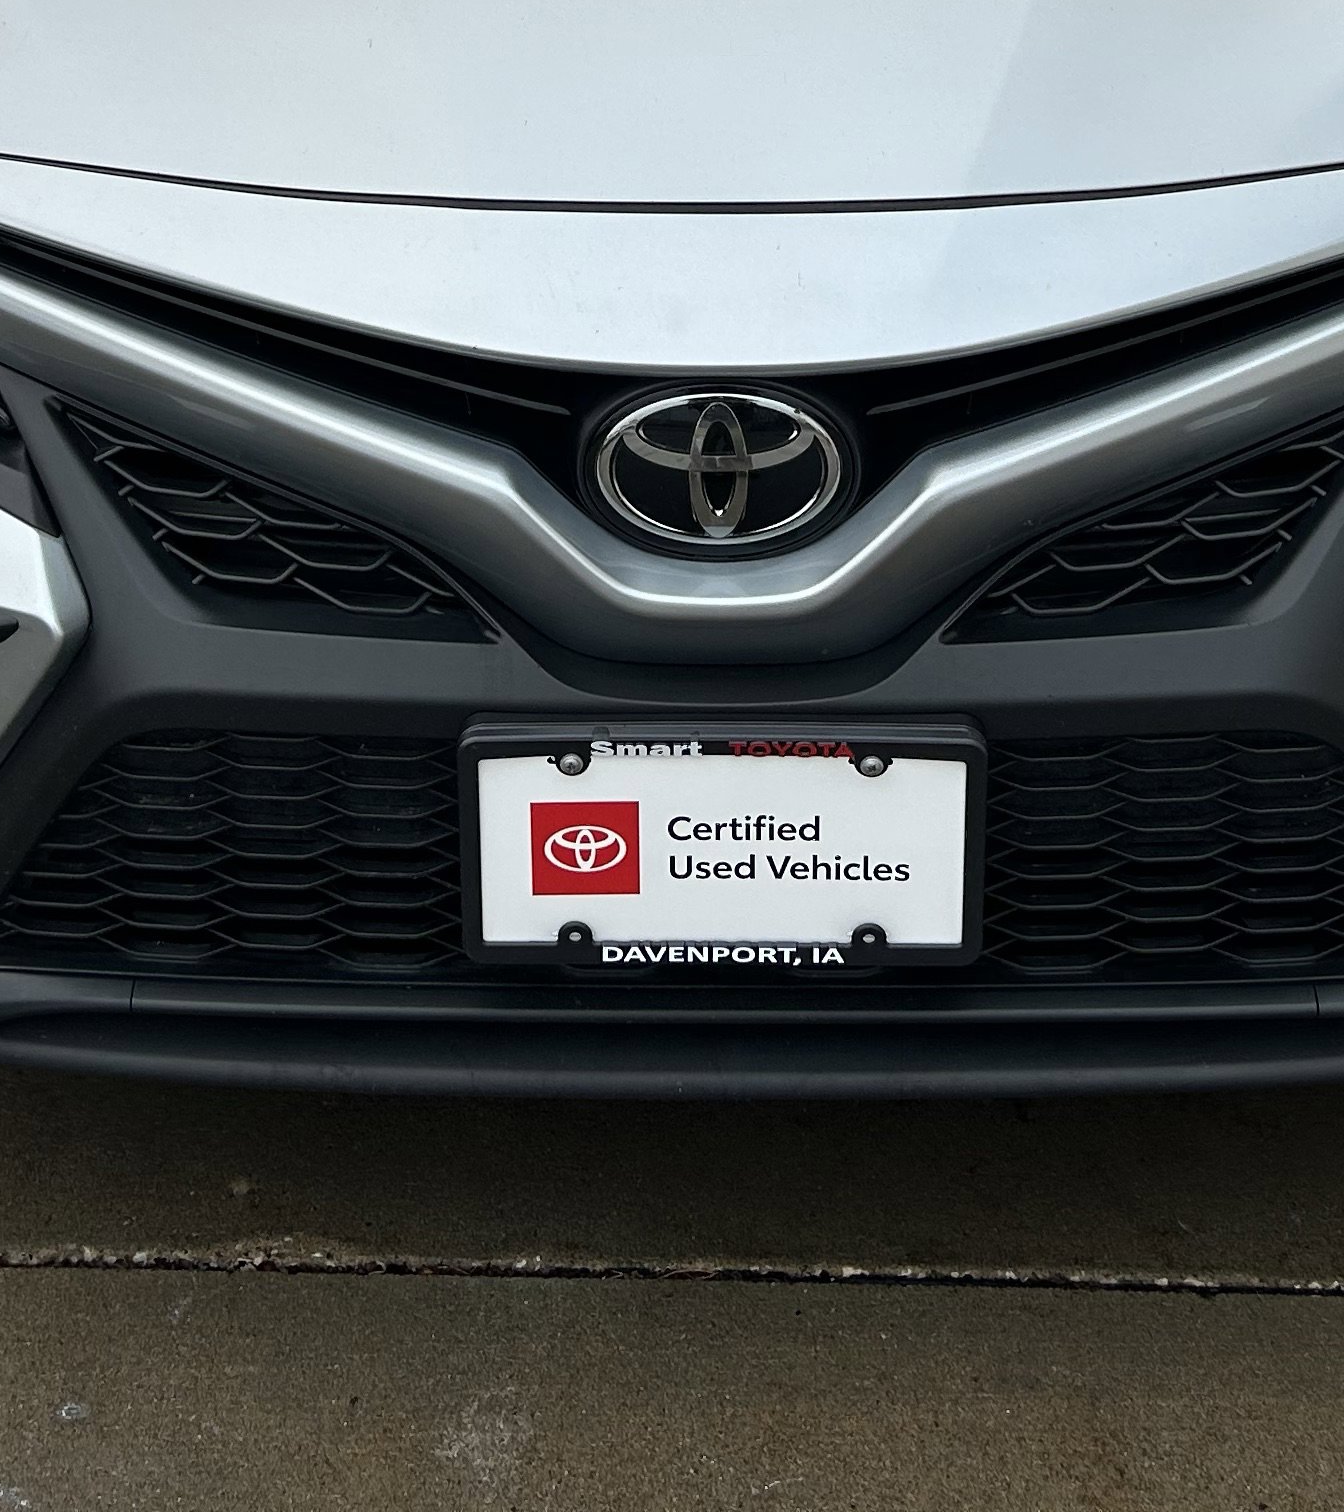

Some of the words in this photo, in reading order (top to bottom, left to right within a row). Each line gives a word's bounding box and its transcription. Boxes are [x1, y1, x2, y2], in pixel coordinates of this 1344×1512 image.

[589, 740, 703, 758] Smart
[728, 741, 855, 758] TOYOTA
[667, 815, 821, 842] Certified
[668, 854, 757, 880] Used
[766, 854, 911, 882] Vehicles
[601, 945, 802, 967] DAVENPORT,
[812, 948, 845, 965] IA
